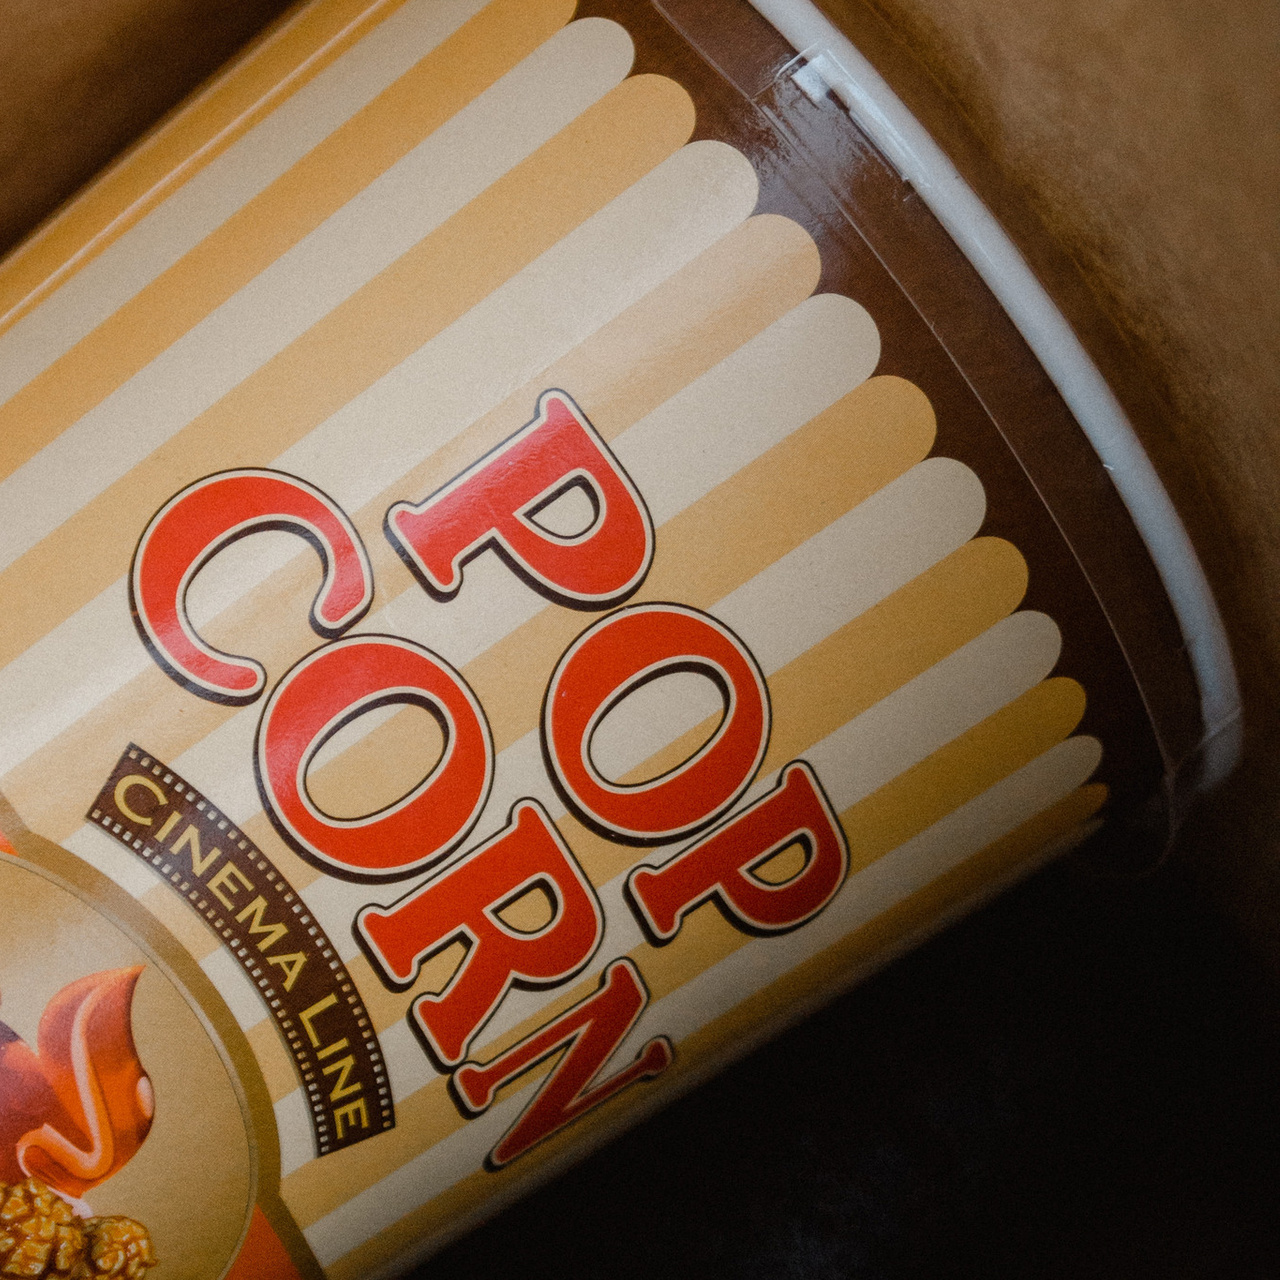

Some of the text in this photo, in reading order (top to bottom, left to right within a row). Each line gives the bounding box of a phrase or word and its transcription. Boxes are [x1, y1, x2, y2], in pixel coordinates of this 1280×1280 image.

[128, 467, 675, 1171] CORN
[384, 387, 850, 937] POP
[114, 775, 370, 1140] CINEMA LINE
